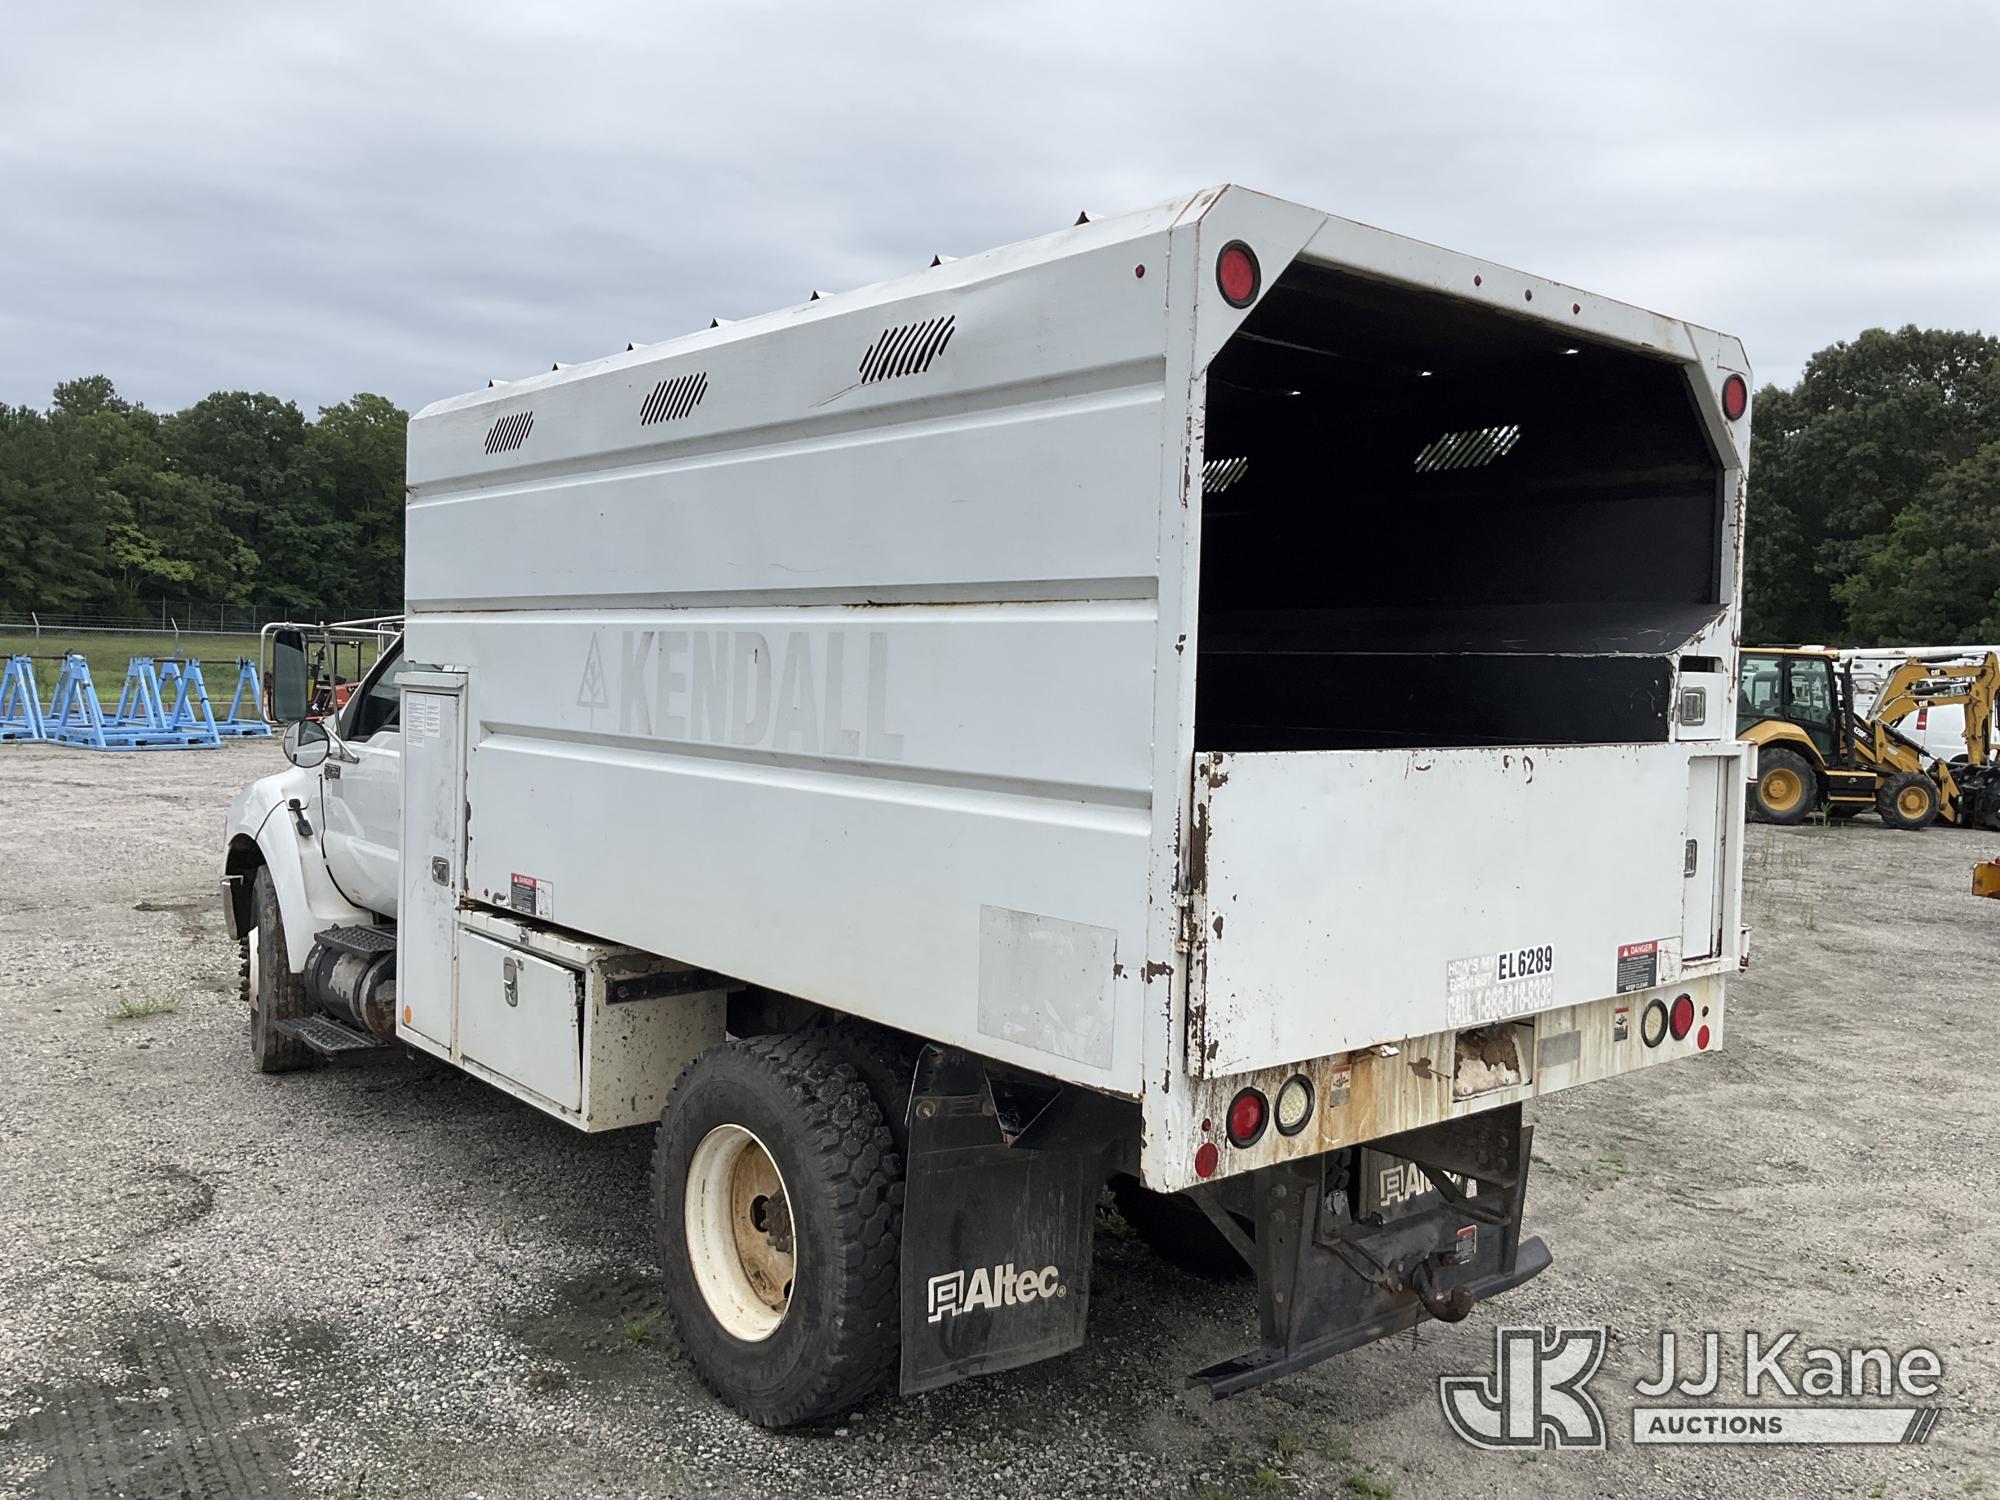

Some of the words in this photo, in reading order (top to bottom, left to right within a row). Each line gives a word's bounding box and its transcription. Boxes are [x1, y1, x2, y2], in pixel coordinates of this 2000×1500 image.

[619, 631, 904, 759] KENDALL
[1499, 945, 1552, 980] EL6289
[1630, 944, 1653, 954] DANGER
[963, 1263, 1059, 1312] Altec
